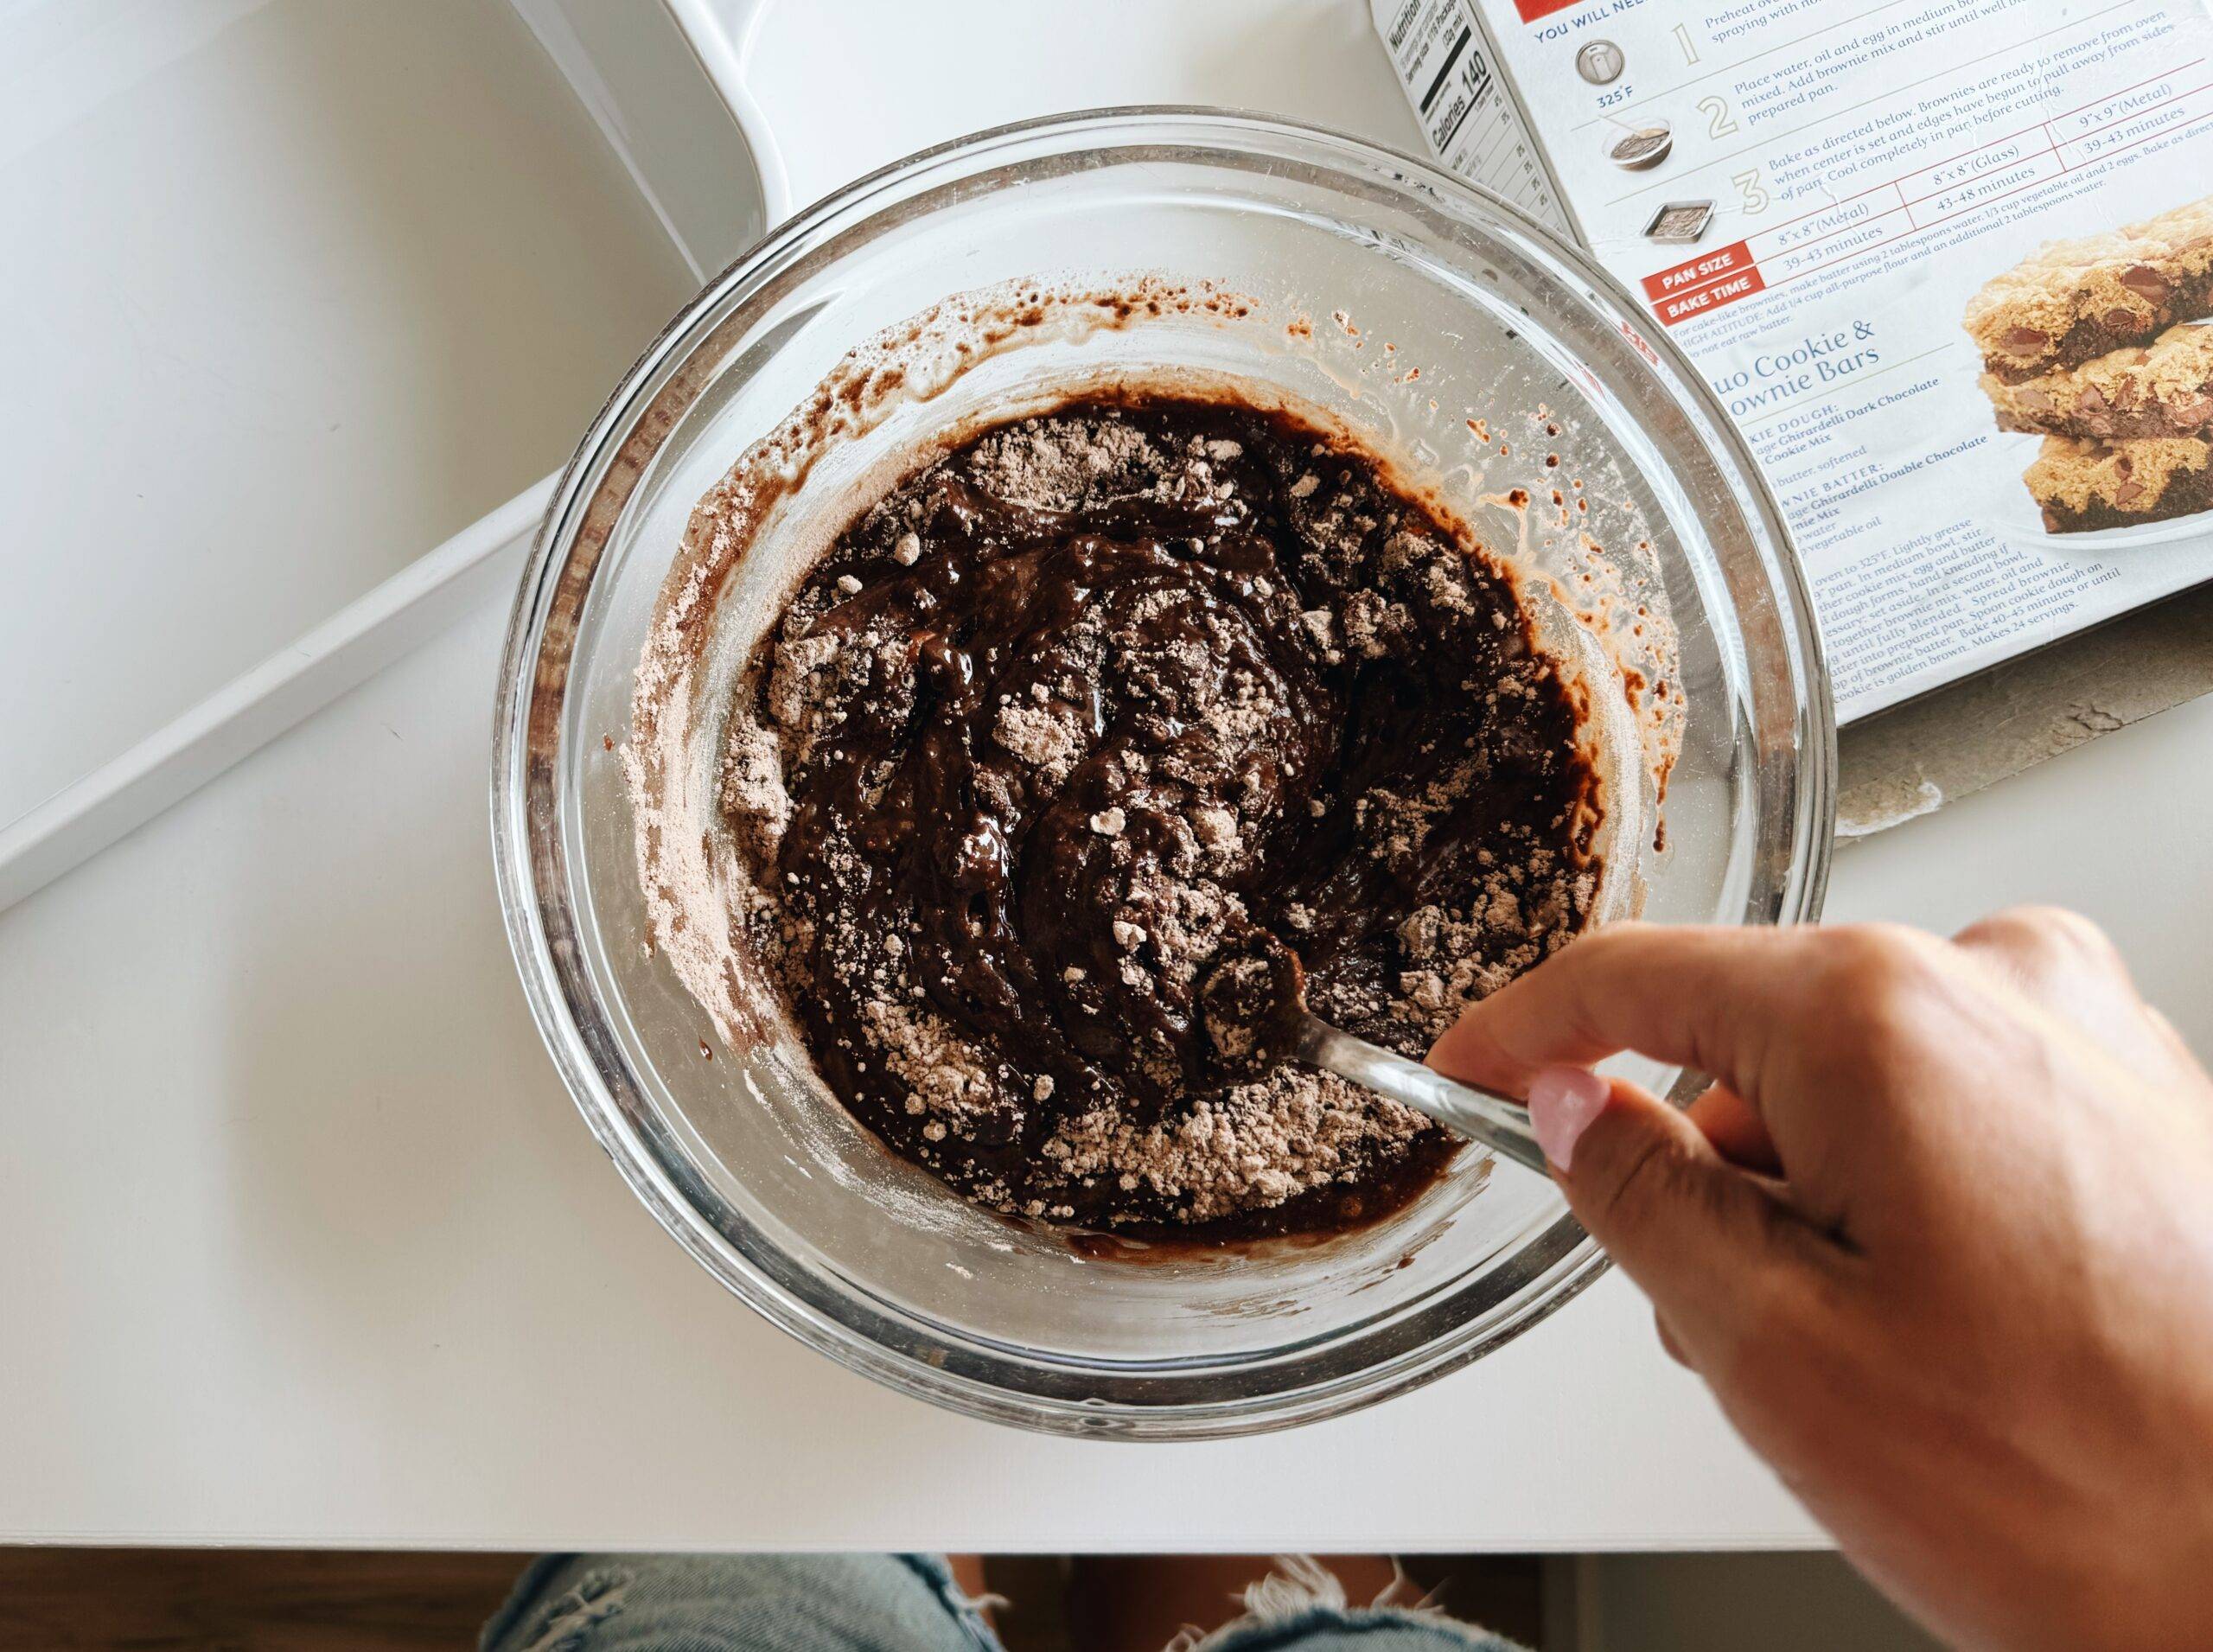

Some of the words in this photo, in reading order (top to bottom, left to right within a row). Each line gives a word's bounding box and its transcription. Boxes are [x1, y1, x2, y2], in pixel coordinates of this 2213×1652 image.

[1388, 0, 1420, 54] Nutrition
[1534, 22, 1568, 43] YOU
[1571, 7, 1610, 29] WILL
[1705, 3, 1757, 29] Preheat
[1711, 16, 1768, 43] spraying
[1768, 2, 1798, 19] with
[1733, 75, 1770, 94] Place
[1814, 48, 1832, 63] oil
[1834, 37, 1860, 55] and
[1862, 30, 1885, 45] egg
[1885, 25, 1901, 35] in
[1902, 3, 1955, 29] medium
[1741, 84, 1785, 109] mixed.
[1789, 71, 1814, 91] Add
[1814, 54, 1868, 79] brownie
[1870, 43, 1896, 58] mix
[1897, 29, 1923, 48] and
[1925, 23, 1945, 36] stir
[1948, 9, 1979, 29] until
[1980, 0, 2006, 15] well
[1432, 95, 1465, 147] Calories
[1462, 50, 1487, 95] 140
[1747, 92, 1806, 126] prepared
[1808, 83, 1838, 102] pan.
[1768, 152, 1802, 170] Bake
[1804, 145, 1820, 156] as
[1821, 121, 1874, 150] directed
[1874, 108, 1916, 129] below.
[1916, 85, 1976, 112] Brownies
[1978, 76, 1999, 90] are
[1999, 62, 2034, 81] ready
[2037, 57, 2050, 71] to
[2052, 37, 2100, 61] remove
[2100, 23, 2133, 44] from
[2134, 10, 2165, 28] oven
[1774, 166, 1810, 185] when
[1812, 149, 1852, 170] center
[1853, 144, 1865, 155] is
[1867, 136, 1887, 150] set
[1888, 123, 1915, 141] and
[1916, 111, 1952, 130] edges
[1952, 99, 1985, 116] have
[1985, 83, 2025, 104] begun
[2026, 77, 2042, 88] to
[2043, 62, 2070, 84] pull
[2071, 50, 2105, 70] away
[2107, 37, 2140, 58] from
[2140, 23, 2174, 41] sides
[1696, 94, 1739, 141] 2
[1781, 186, 1794, 201] of
[1795, 177, 1824, 197] pan.
[1827, 162, 1859, 181] Cool
[1859, 137, 1928, 169] completely
[1929, 131, 1944, 142] in
[1946, 120, 1972, 138] pan
[1972, 105, 2012, 124] before
[2014, 85, 2064, 109] cutting.
[1729, 167, 1770, 215] 3
[1661, 266, 1696, 290] PAN
[1698, 252, 1733, 275] SIZE
[1667, 291, 1710, 317] BAKE
[1709, 276, 1751, 300] TIME
[1754, 332, 1849, 378] Cookie
[1853, 320, 1875, 341] &
[1814, 348, 1879, 381] Bars
[1776, 404, 1839, 433] DOUGH:
[1777, 412, 1845, 445] Ghirardelli
[1845, 402, 1877, 419] Dark
[1877, 378, 1939, 406] Chocolate
[1764, 443, 1808, 464] Cookie
[1808, 433, 1832, 448] Mix
[1810, 477, 1878, 510] Ghirardelli
[1878, 461, 1923, 483] Double
[1924, 436, 1987, 464] Chocolate
[1821, 462, 1884, 492] BATTER:
[1816, 507, 1840, 520] Mix
